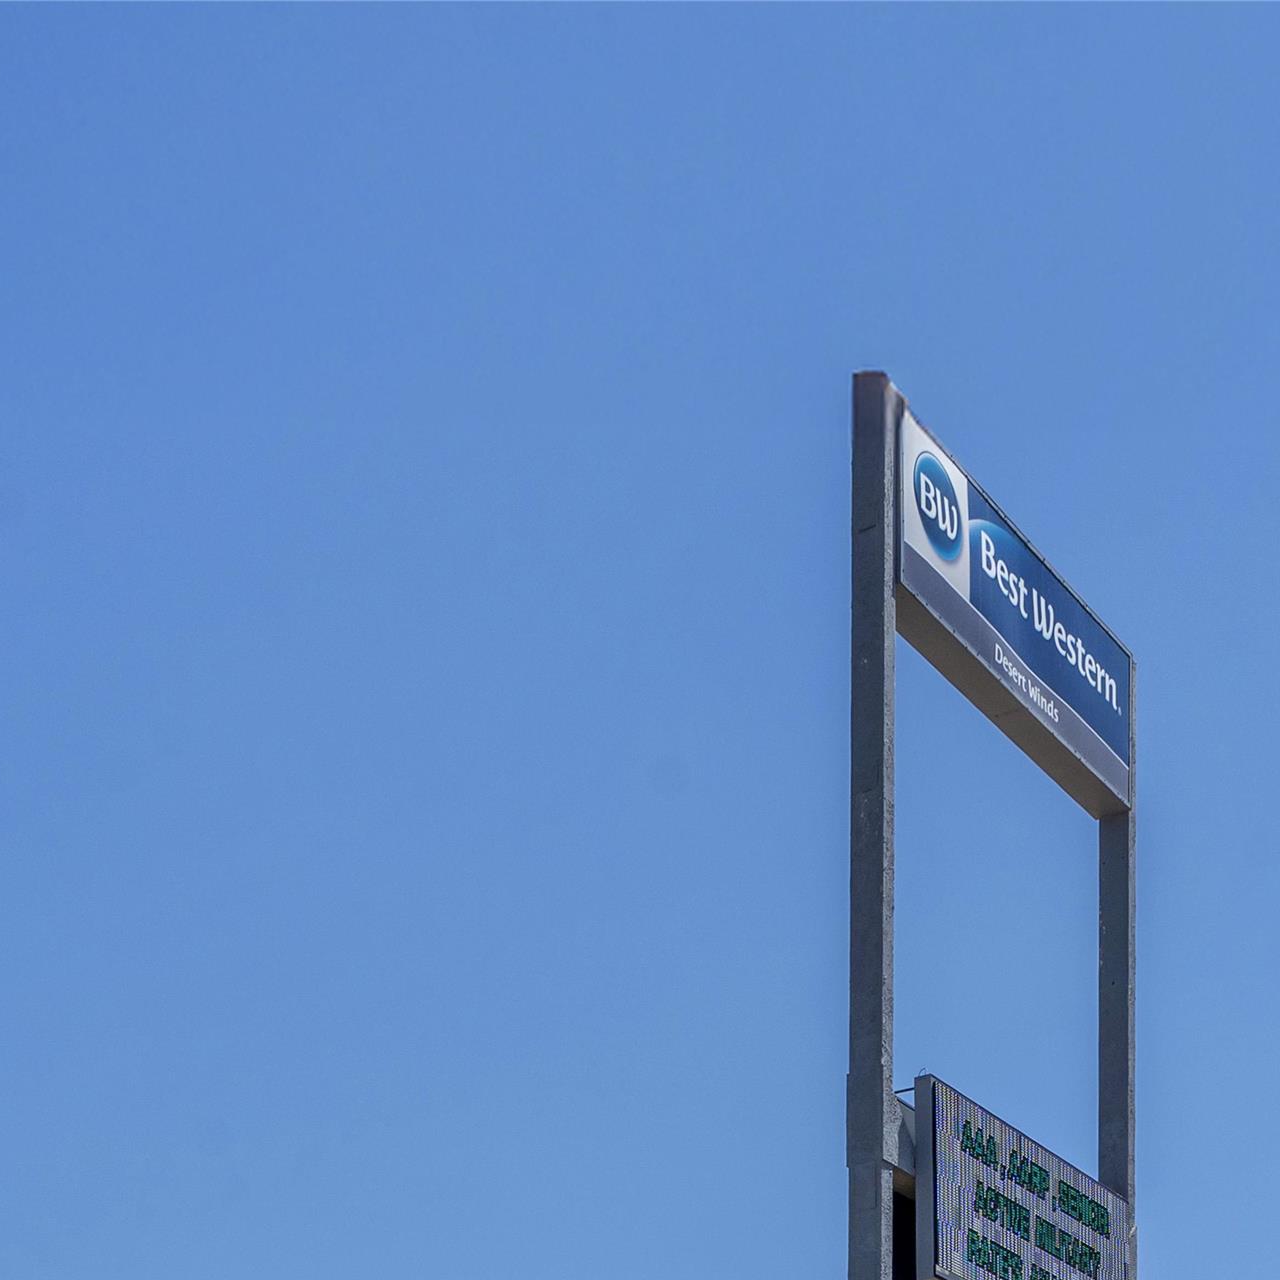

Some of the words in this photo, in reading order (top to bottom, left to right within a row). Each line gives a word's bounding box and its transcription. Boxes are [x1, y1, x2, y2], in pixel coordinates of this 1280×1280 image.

[920, 472, 957, 540] BW
[981, 530, 1028, 619] Best
[1032, 588, 1119, 711] Western
[994, 642, 1027, 694] Desert
[1028, 676, 1059, 723] Winds
[974, 1180, 1030, 1241] ACTIVE
[1036, 1215, 1100, 1280] MILITARY
